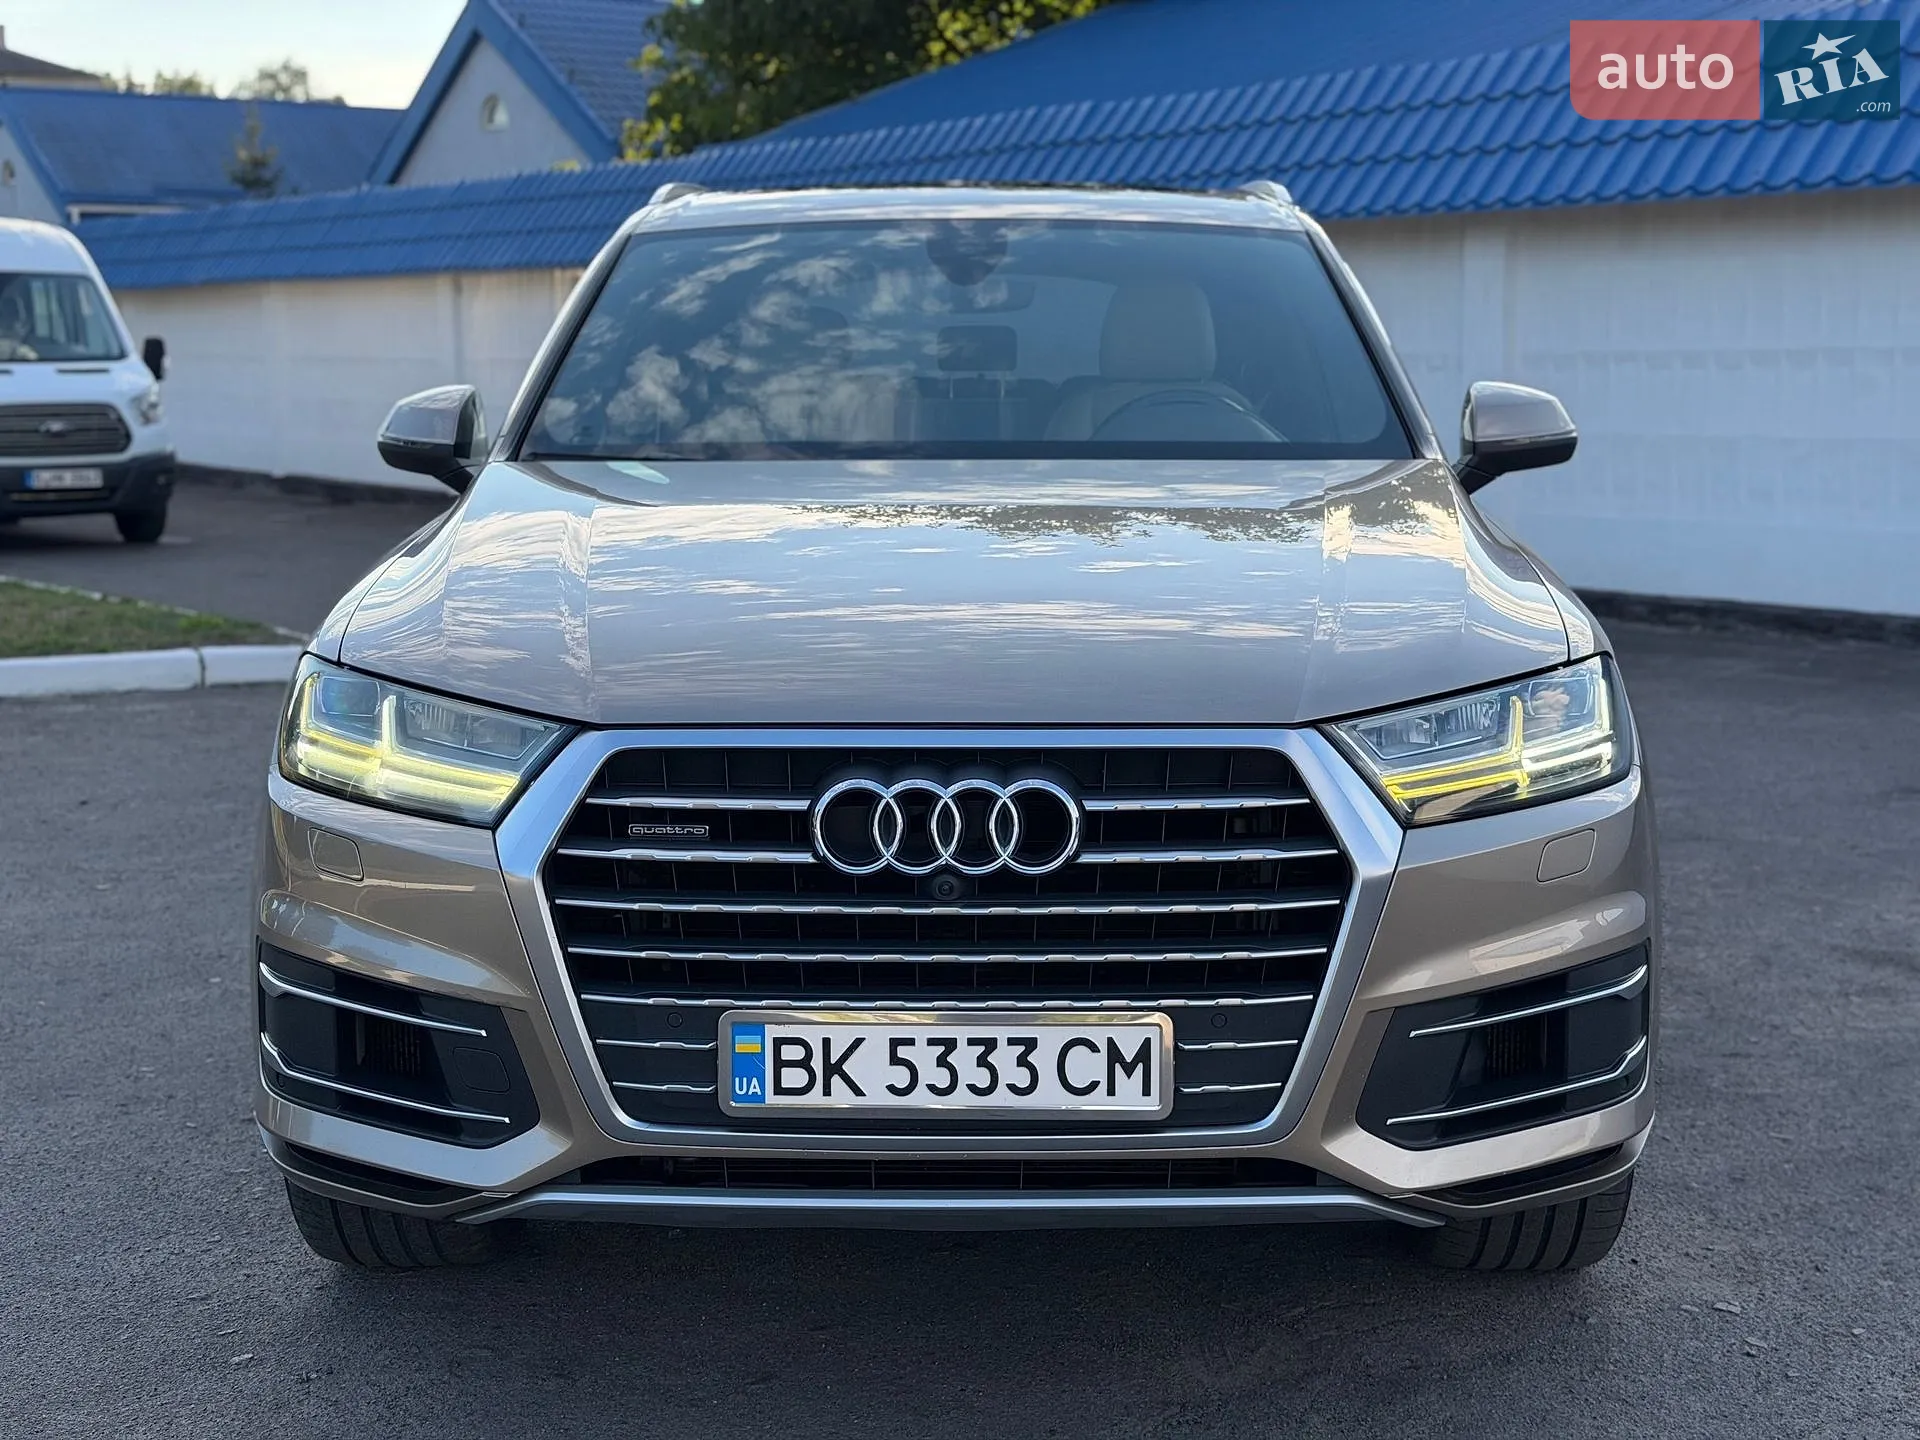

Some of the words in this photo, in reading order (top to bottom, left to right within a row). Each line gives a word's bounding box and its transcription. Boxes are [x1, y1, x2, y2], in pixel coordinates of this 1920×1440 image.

[632, 826, 705, 835] quattro
[772, 1037, 866, 1098] BK
[885, 1037, 1039, 1098] 5333
[1056, 1037, 1151, 1098] CM
[734, 1077, 762, 1096] UA
